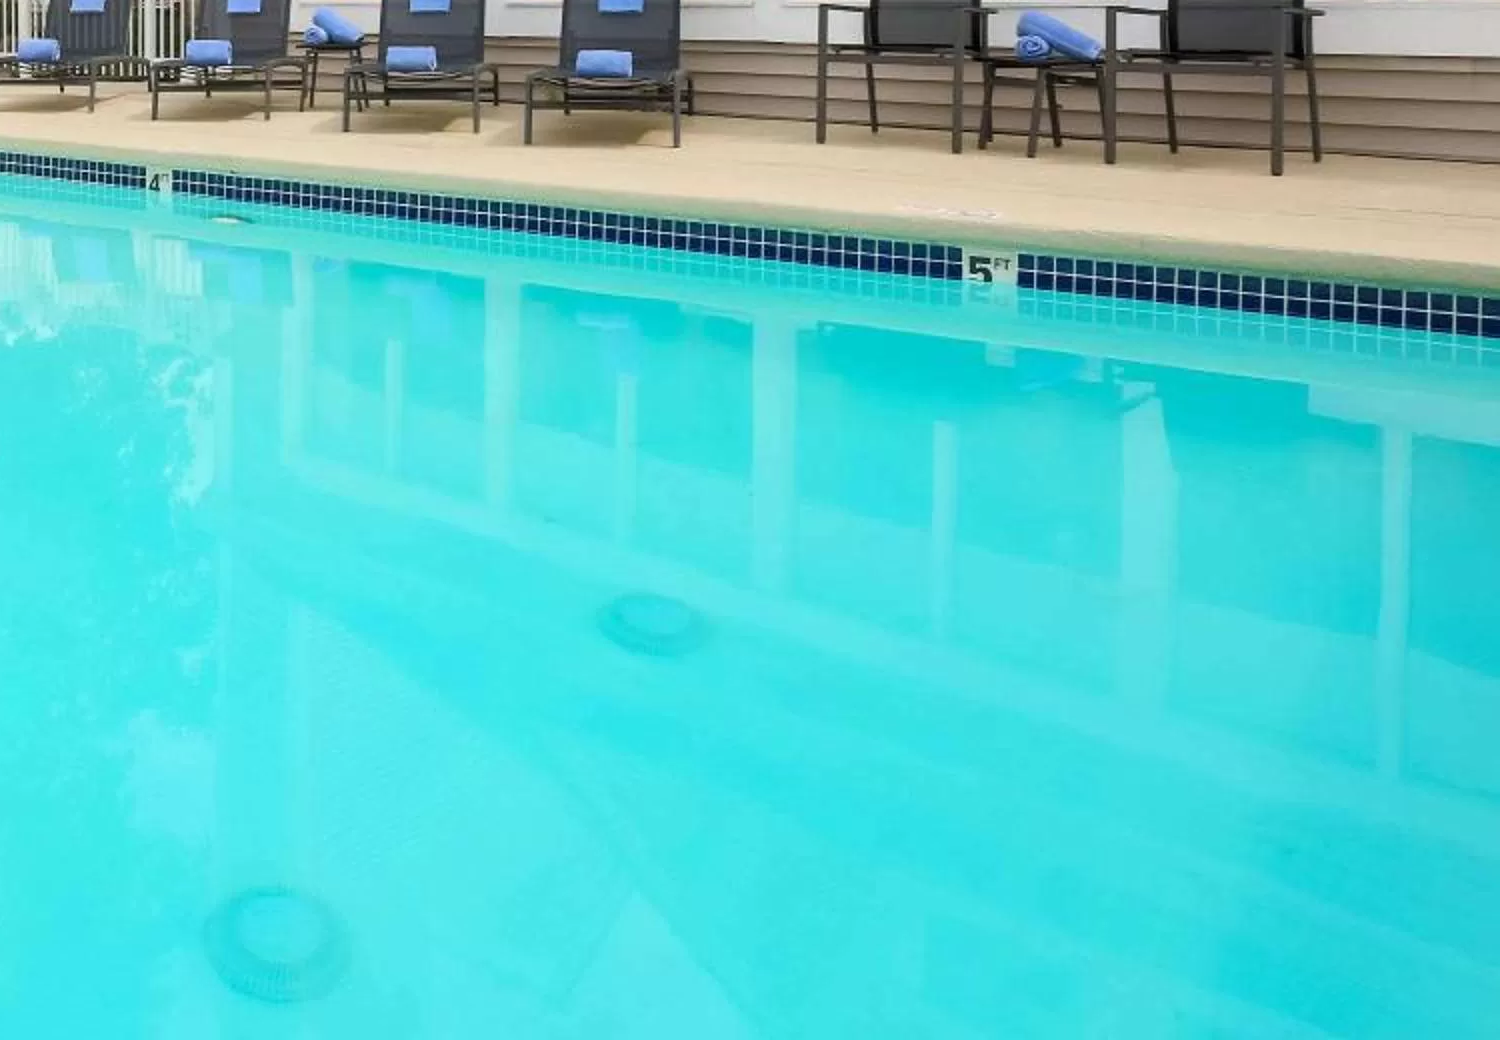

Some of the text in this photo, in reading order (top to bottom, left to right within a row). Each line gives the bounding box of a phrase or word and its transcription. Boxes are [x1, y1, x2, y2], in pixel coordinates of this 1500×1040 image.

[148, 173, 160, 191] 4
[969, 256, 1011, 282] 5 FT
